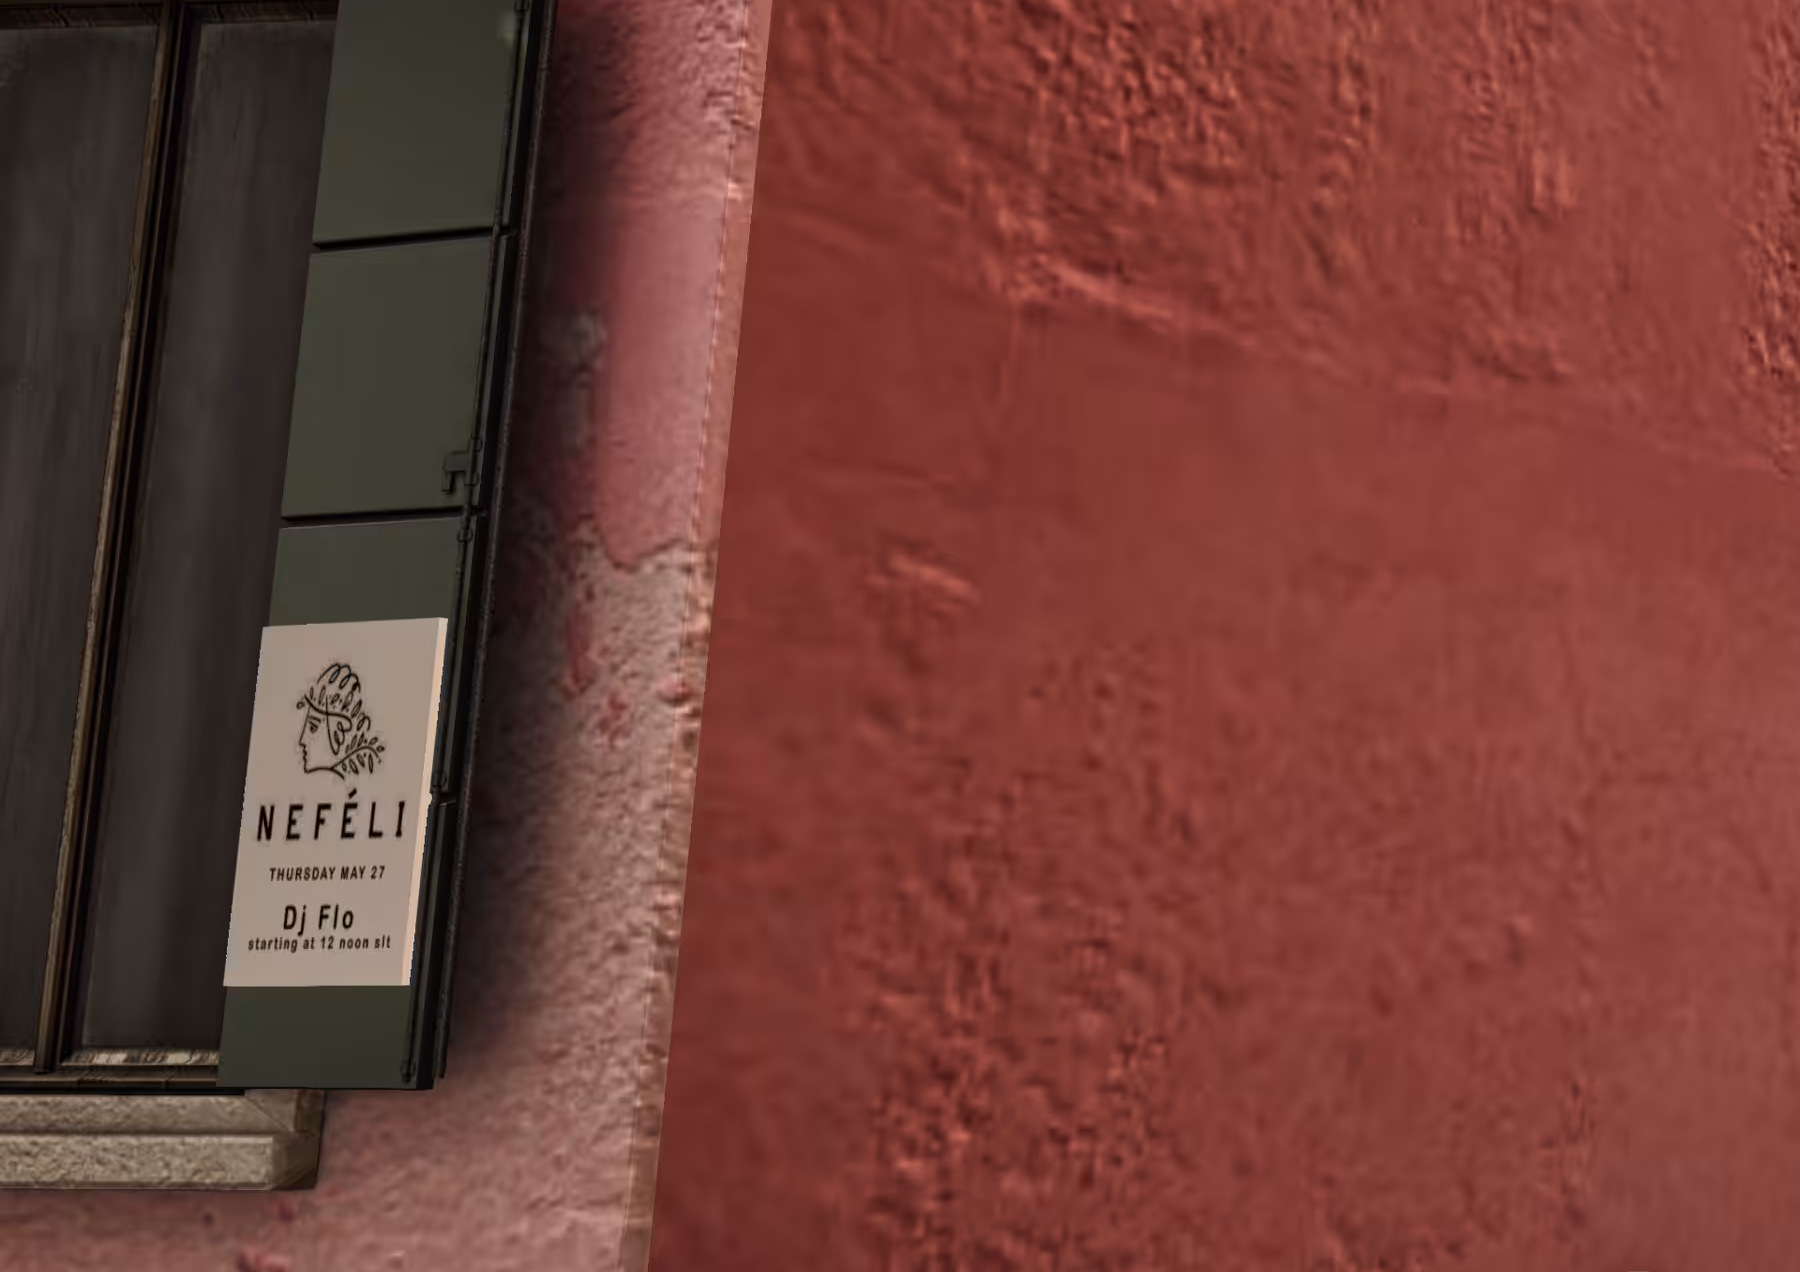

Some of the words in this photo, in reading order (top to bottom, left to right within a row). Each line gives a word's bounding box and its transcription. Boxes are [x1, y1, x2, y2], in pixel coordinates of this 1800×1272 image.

[256, 787, 406, 841] NEFÉLI
[269, 866, 336, 881] THURSDAY
[340, 865, 366, 880] MAY
[370, 865, 386, 879] 27
[282, 904, 307, 936] Dj
[318, 903, 354, 930] Flo
[248, 937, 298, 954] starting
[302, 937, 315, 950] at
[320, 936, 335, 949] 12
[339, 937, 369, 949] noon
[374, 935, 392, 949] slt
